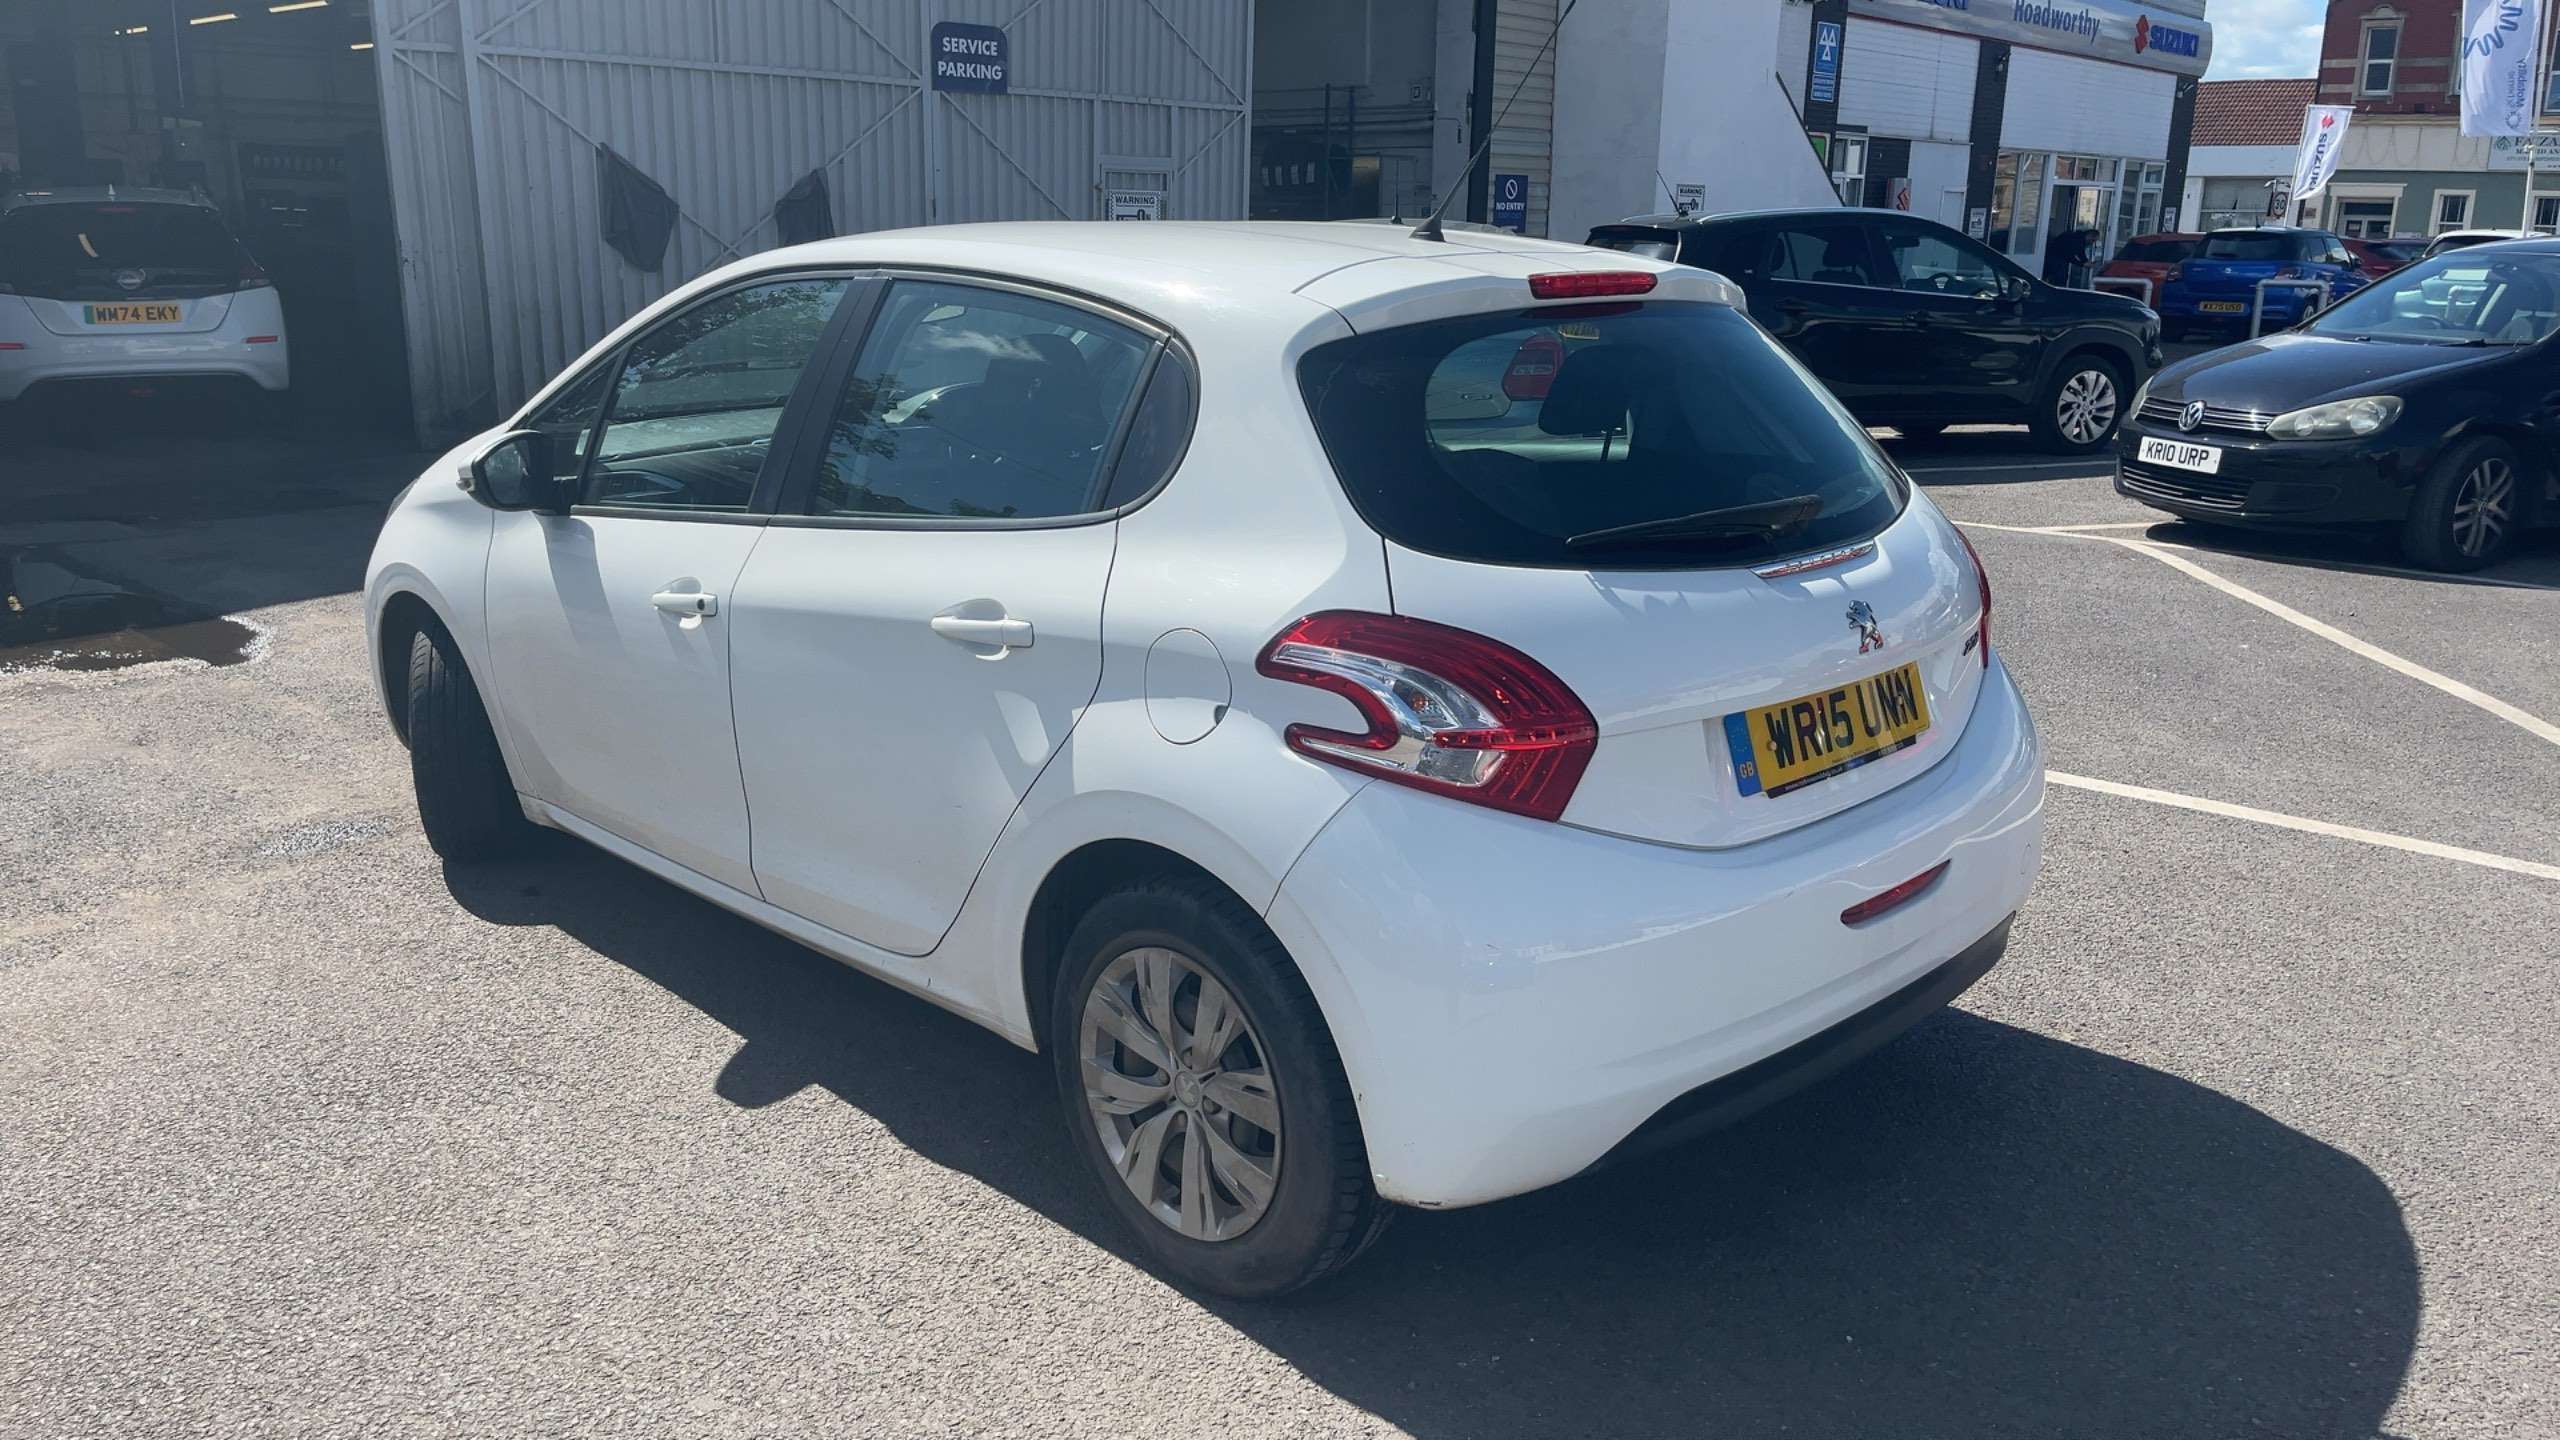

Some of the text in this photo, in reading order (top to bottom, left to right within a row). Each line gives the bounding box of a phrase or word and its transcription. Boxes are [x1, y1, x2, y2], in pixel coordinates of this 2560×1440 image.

[2014, 0, 2100, 45] Roadworthy
[942, 36, 998, 56] SERVICE
[2149, 25, 2199, 57] SUZUKI
[937, 60, 1003, 80] PARKING
[2308, 132, 2328, 191] SUZUKI
[1115, 195, 1156, 205] WARNING
[1495, 202, 1525, 211] NO ENTRY
[2275, 199, 2286, 210] 30
[95, 306, 178, 321] WM74 EKY
[2145, 441, 2210, 467] KR10 URP
[1764, 690, 1855, 770] WR15
[1856, 668, 1919, 739] UNN
[1739, 761, 1754, 779] GB
